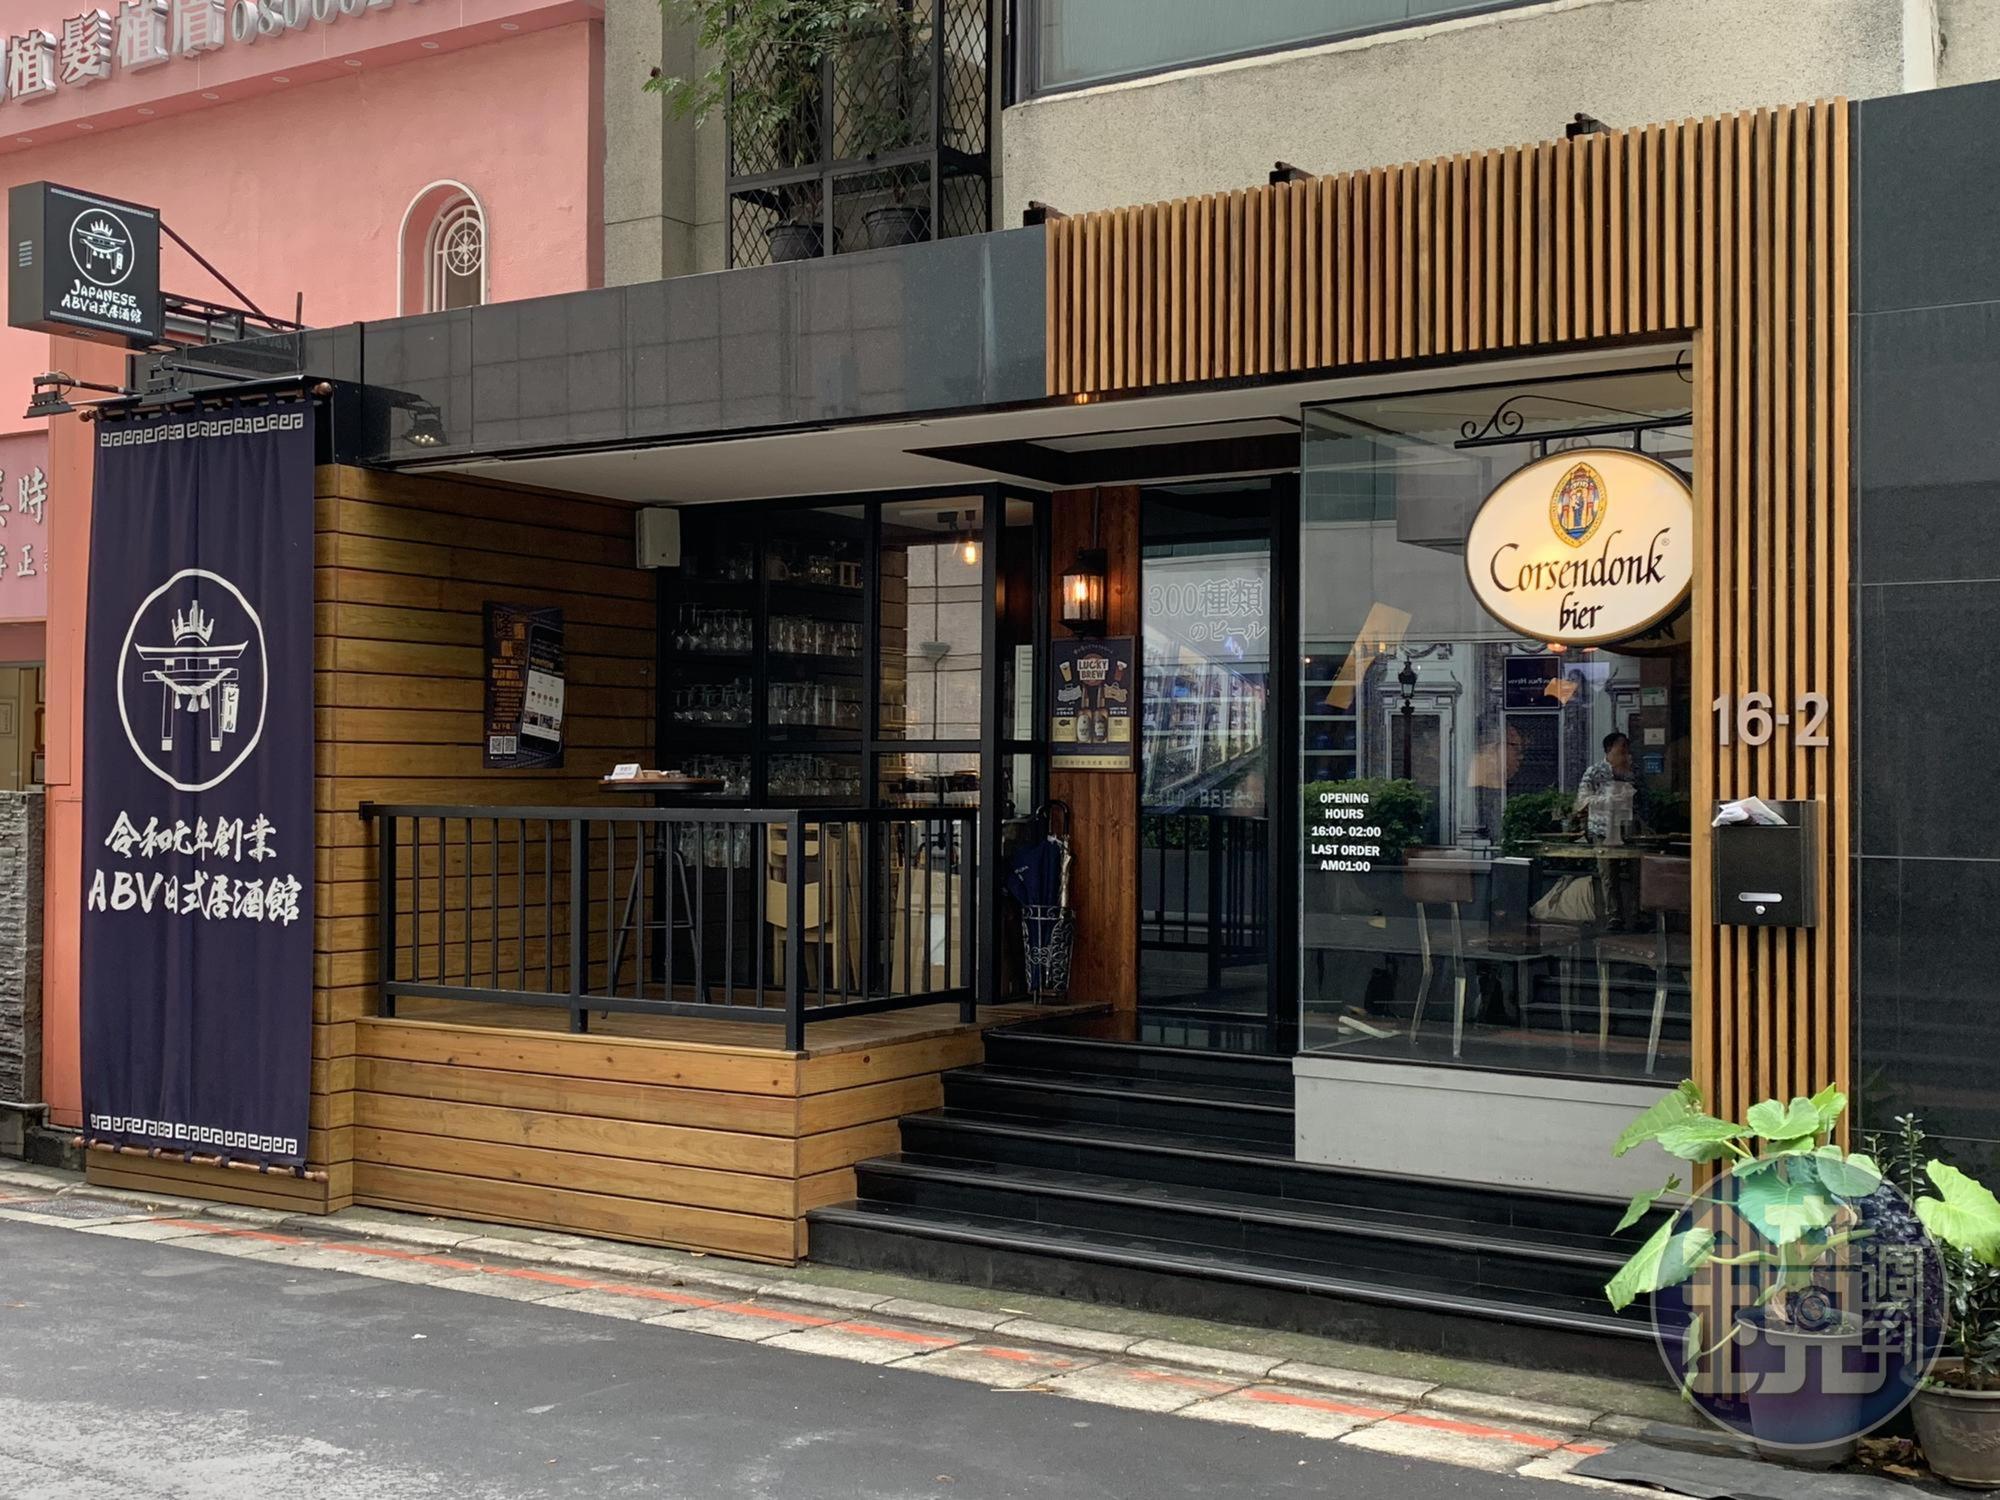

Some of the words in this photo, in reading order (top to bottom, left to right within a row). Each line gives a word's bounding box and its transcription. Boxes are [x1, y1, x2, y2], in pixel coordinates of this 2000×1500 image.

[70, 279, 137, 308] JAPANESE
[1149, 577, 1264, 617] 300種類
[1559, 591, 1604, 631] bier
[1189, 620, 1267, 642] のビール
[1078, 660, 1108, 671] LUCKY
[1081, 670, 1104, 680] BREW
[225, 690, 237, 731] ビール
[1712, 691, 1830, 746] 16-2
[1199, 787, 1256, 809] BEERS
[1320, 793, 1369, 804] OPENING
[1325, 808, 1364, 819] HOURS
[1348, 826, 1382, 837] 02:00
[1311, 844, 1339, 855] LAST
[1340, 845, 1380, 857] ORDER
[1320, 860, 1371, 872] AM01:00
[88, 868, 303, 926] ABV日式居酒館
